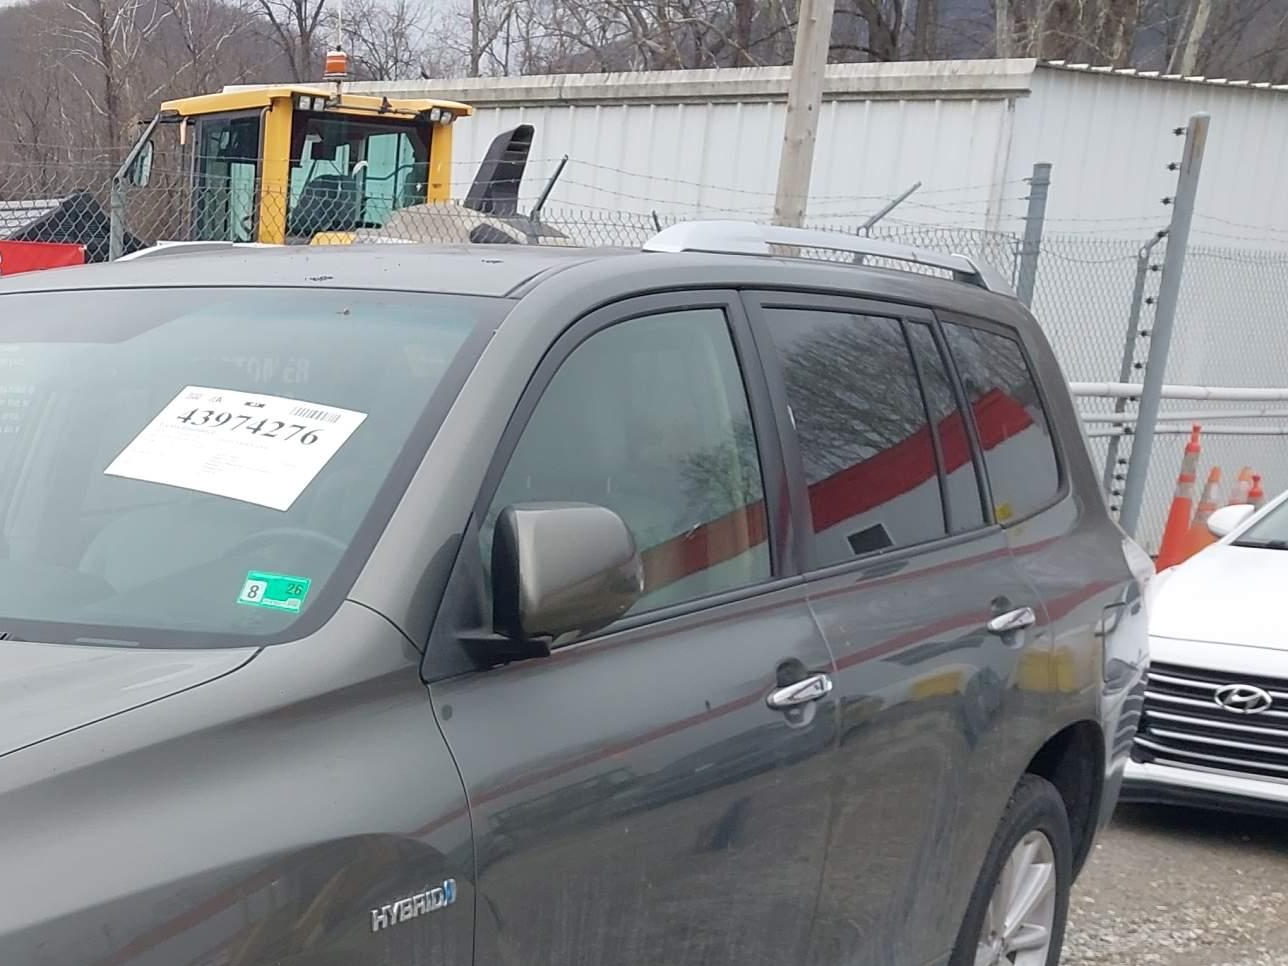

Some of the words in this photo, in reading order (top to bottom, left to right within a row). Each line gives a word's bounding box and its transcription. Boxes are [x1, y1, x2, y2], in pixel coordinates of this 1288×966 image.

[177, 407, 325, 446] 43974276
[247, 584, 260, 599] 8
[370, 887, 445, 932] HYBRID
